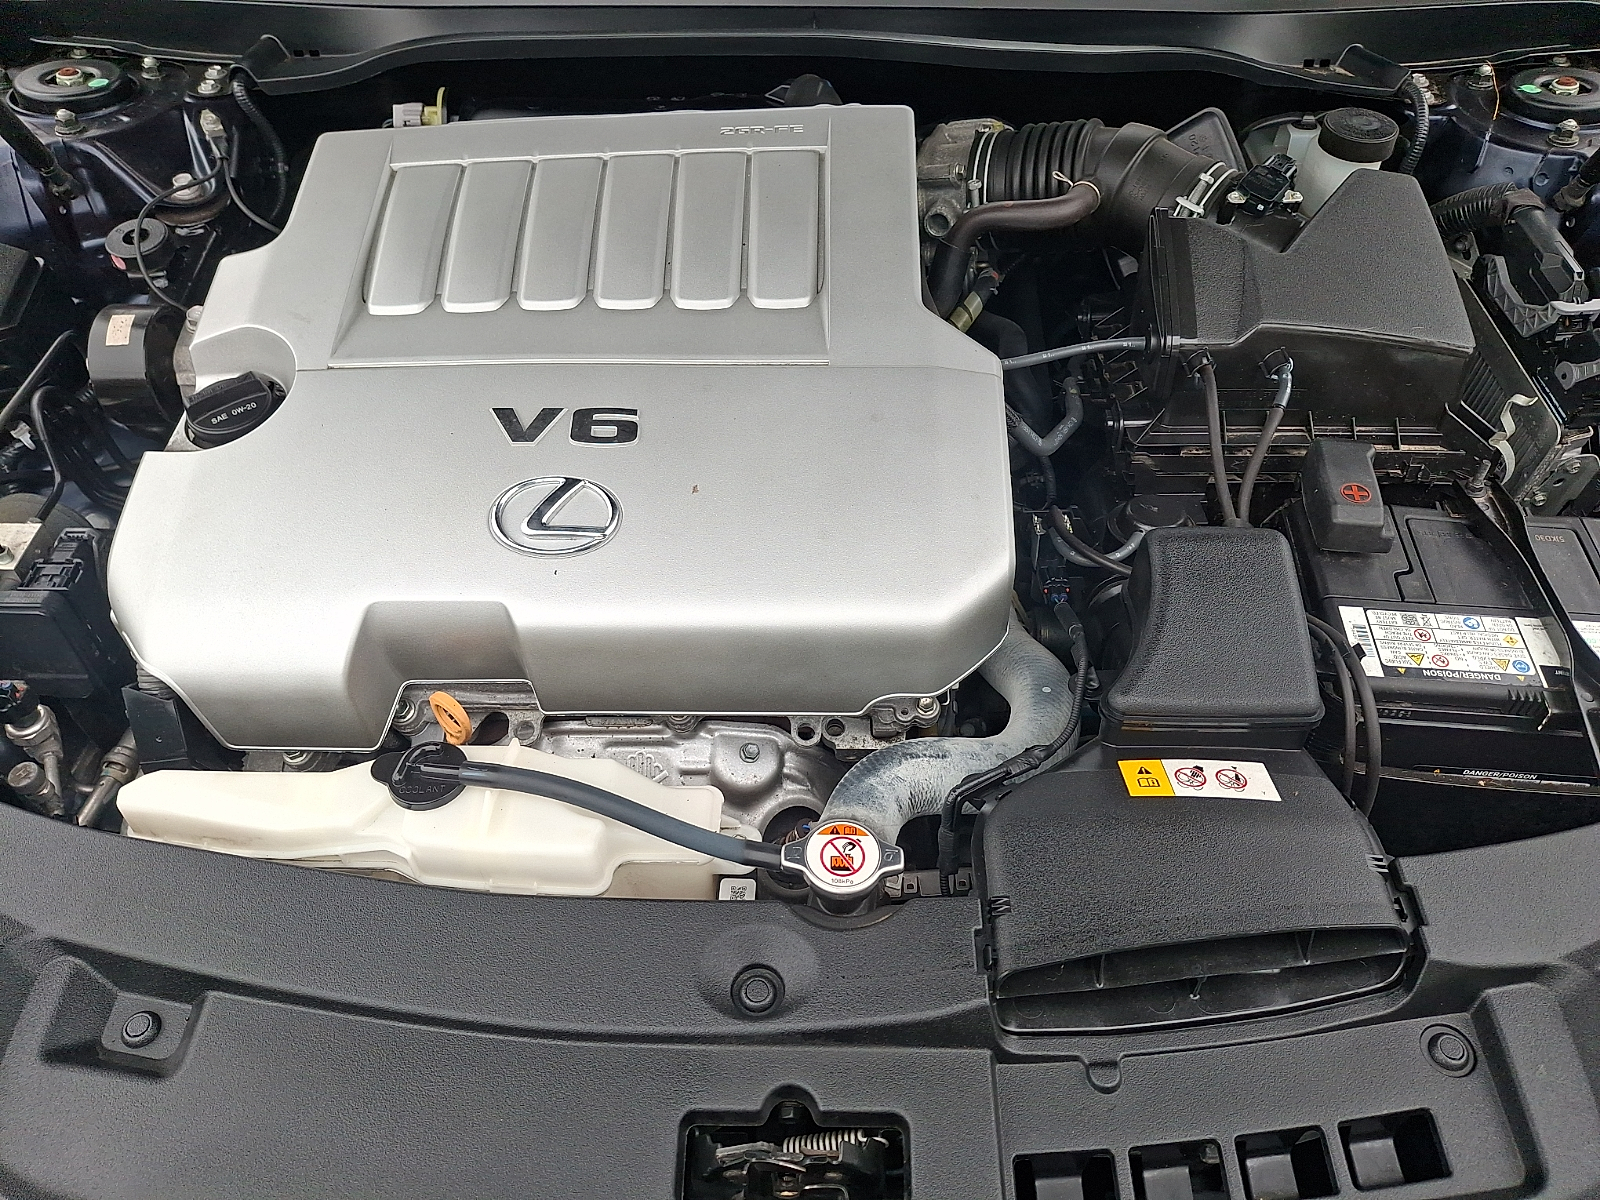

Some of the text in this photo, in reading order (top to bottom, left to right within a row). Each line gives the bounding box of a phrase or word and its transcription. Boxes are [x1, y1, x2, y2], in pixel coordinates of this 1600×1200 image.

[720, 124, 804, 136] 2GR-FE
[211, 402, 257, 424] SAE 0W-20
[489, 406, 640, 448] V6
[1422, 669, 1502, 681] DANGER/POISON
[1462, 769, 1538, 780] DANGER/POISON
[398, 784, 446, 794] COOLANT
